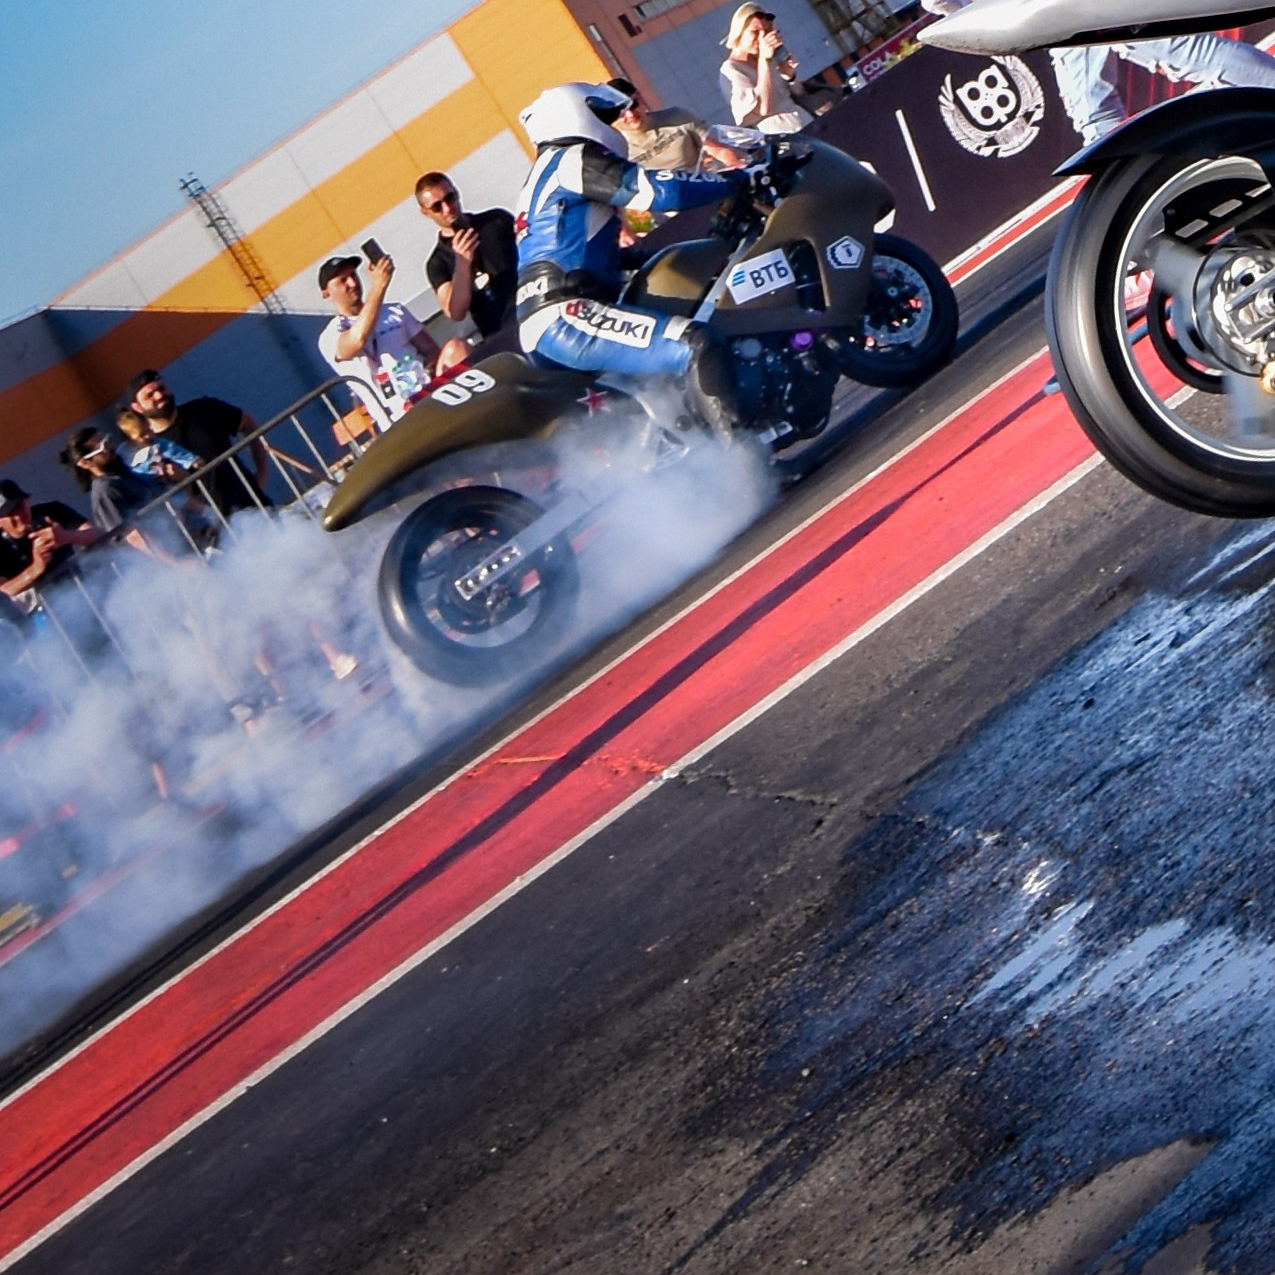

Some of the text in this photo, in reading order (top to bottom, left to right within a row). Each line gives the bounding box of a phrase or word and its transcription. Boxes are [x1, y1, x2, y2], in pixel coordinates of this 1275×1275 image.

[655, 169, 728, 183] SUZUK
[750, 260, 789, 288] ВТБ
[577, 306, 651, 340] SUZUKI
[431, 368, 496, 406] 09
